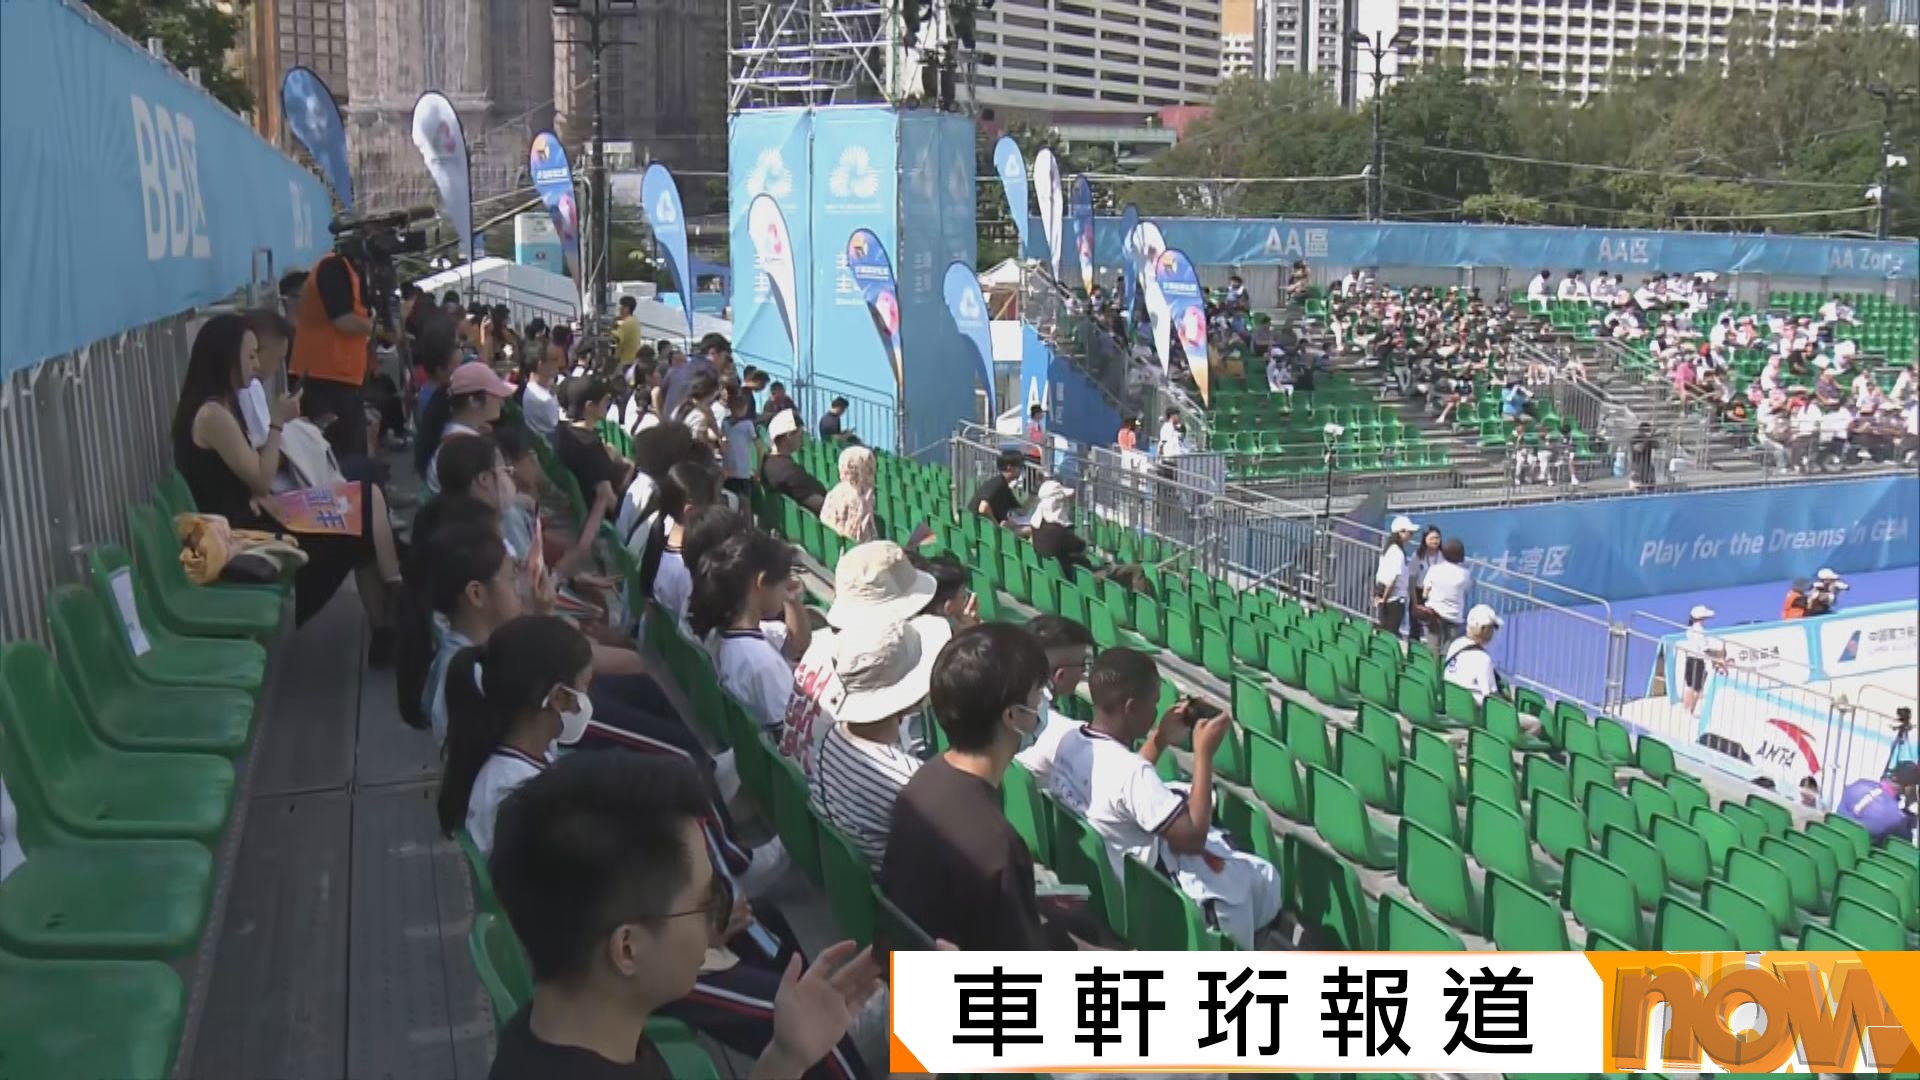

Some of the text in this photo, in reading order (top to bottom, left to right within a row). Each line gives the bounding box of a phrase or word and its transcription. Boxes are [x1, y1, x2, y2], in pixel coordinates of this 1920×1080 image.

[1263, 226, 1329, 257] AA區
[1597, 236, 1649, 263] AA区
[1639, 539, 1686, 567] Play
[1691, 534, 1725, 560] for
[1729, 532, 1765, 556] the
[1768, 527, 1847, 553] Dreams
[1755, 740, 1796, 768] ANTA
